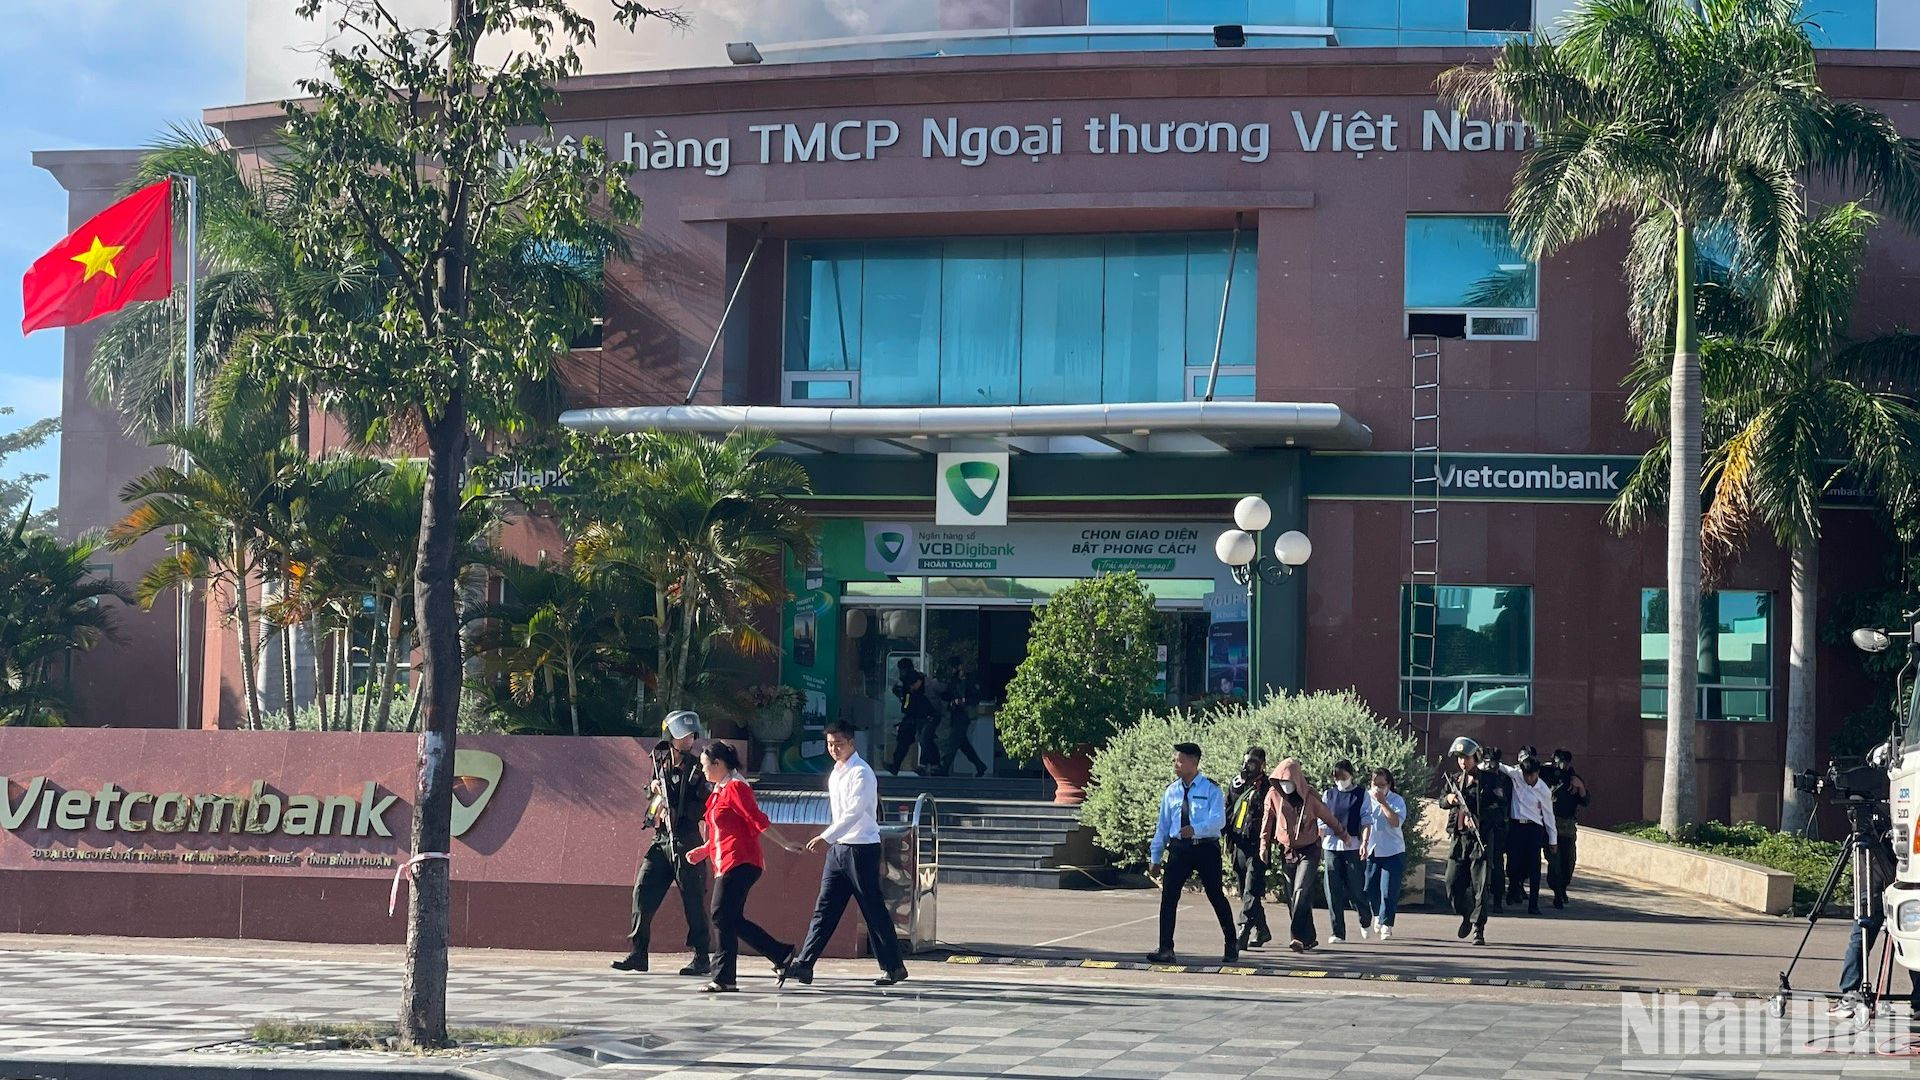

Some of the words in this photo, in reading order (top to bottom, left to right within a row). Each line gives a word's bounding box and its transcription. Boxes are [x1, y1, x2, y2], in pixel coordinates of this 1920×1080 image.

[623, 128, 730, 177] hàng
[748, 119, 901, 164] TMCP
[922, 115, 1063, 166] Ngoại
[1085, 113, 1269, 163] thương
[1291, 110, 1398, 159] Việt
[1434, 464, 1619, 490] Vietcombank
[919, 532, 940, 540] Ngân
[943, 532, 963, 540] hàng
[966, 532, 976, 540] số
[1081, 530, 1121, 541] CHỌN
[1125, 530, 1160, 540] GIAO
[1164, 527, 1198, 541] DIỆN
[919, 543, 952, 555] VCB
[955, 543, 1015, 558] Digibank
[1071, 541, 1098, 556] BẬT
[1103, 544, 1153, 554] PHONG
[1158, 542, 1196, 554] CÁCH
[923, 560, 948, 568] HOÀN
[950, 560, 973, 568] TOÀN
[0, 774, 398, 836] Vietcombank
